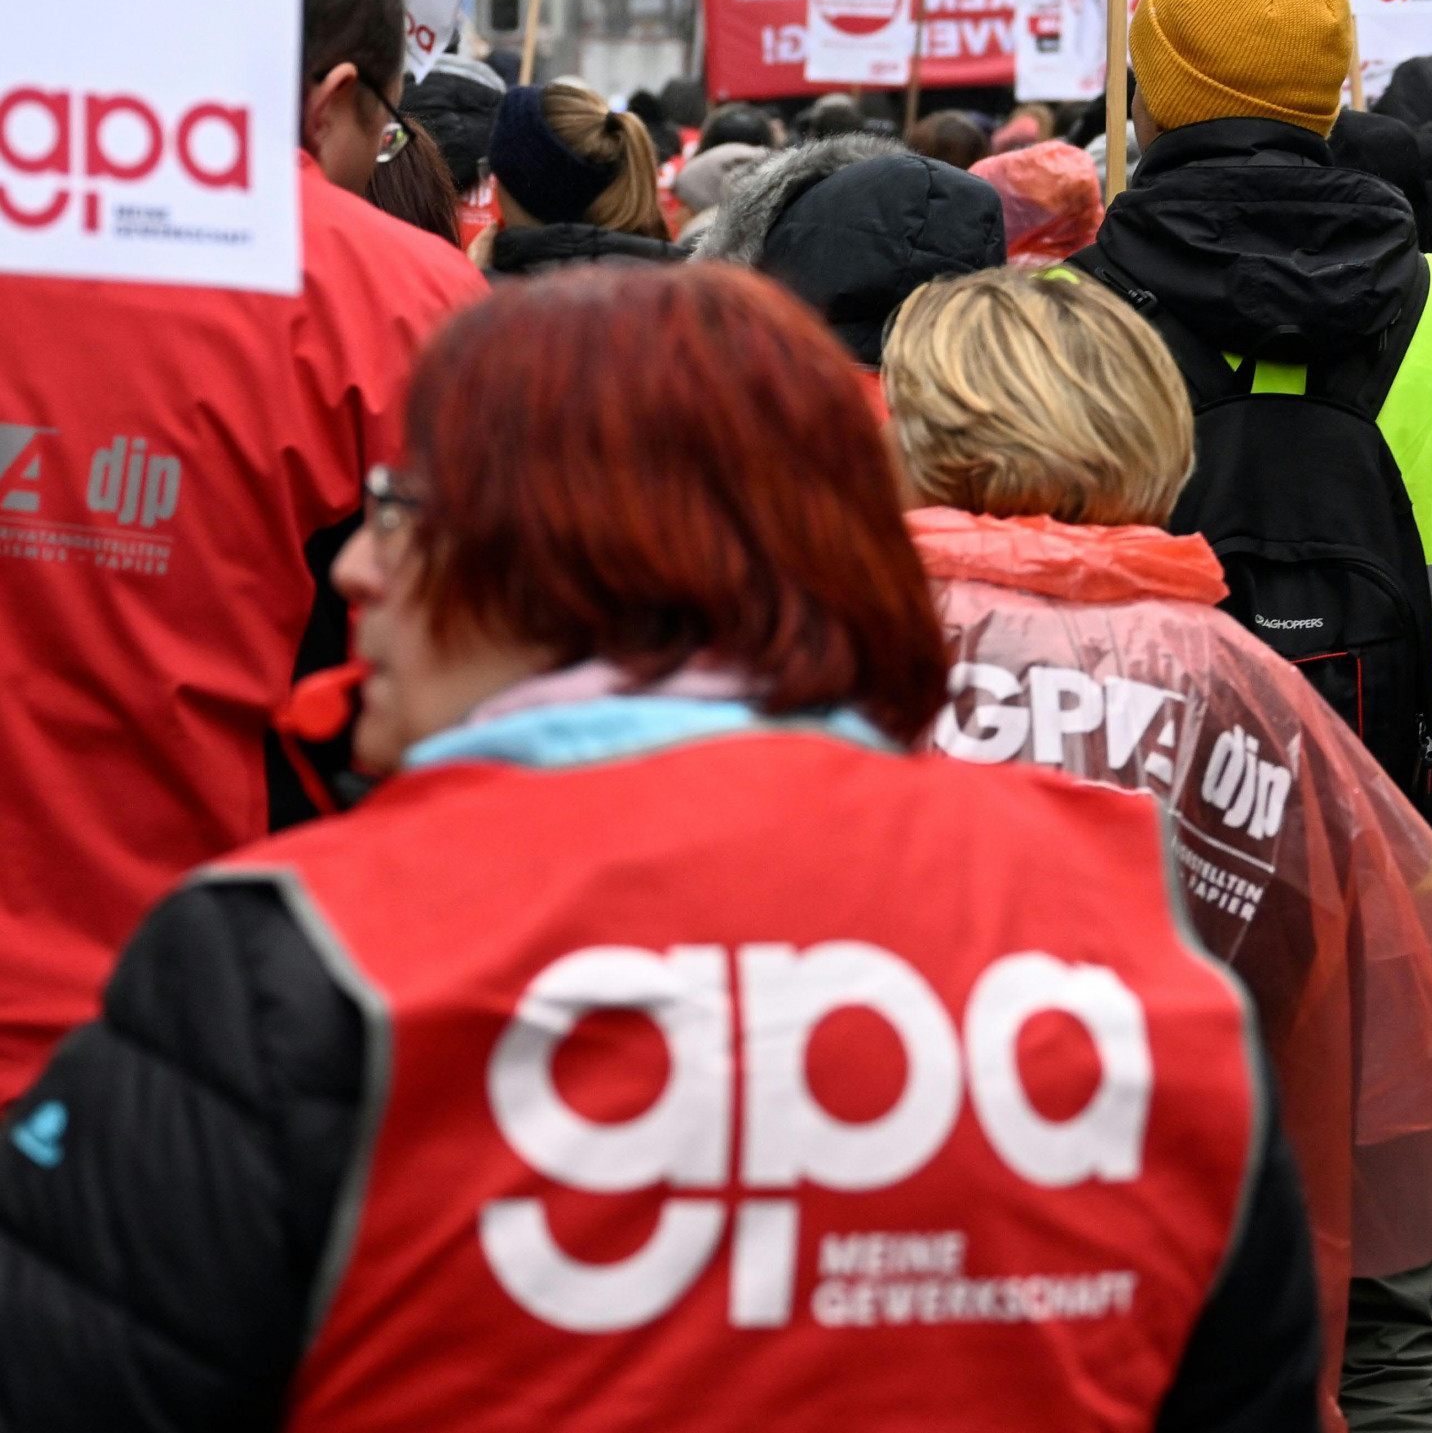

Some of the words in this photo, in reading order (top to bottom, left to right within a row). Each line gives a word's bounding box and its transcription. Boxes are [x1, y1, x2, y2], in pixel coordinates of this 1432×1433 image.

[0, 86, 252, 234] gpa
[86, 435, 182, 528] djp
[478, 938, 1154, 1335] gpa
[810, 1271, 1139, 1328] GEWERKSCHAFT
[816, 1230, 968, 1278] MEINE
